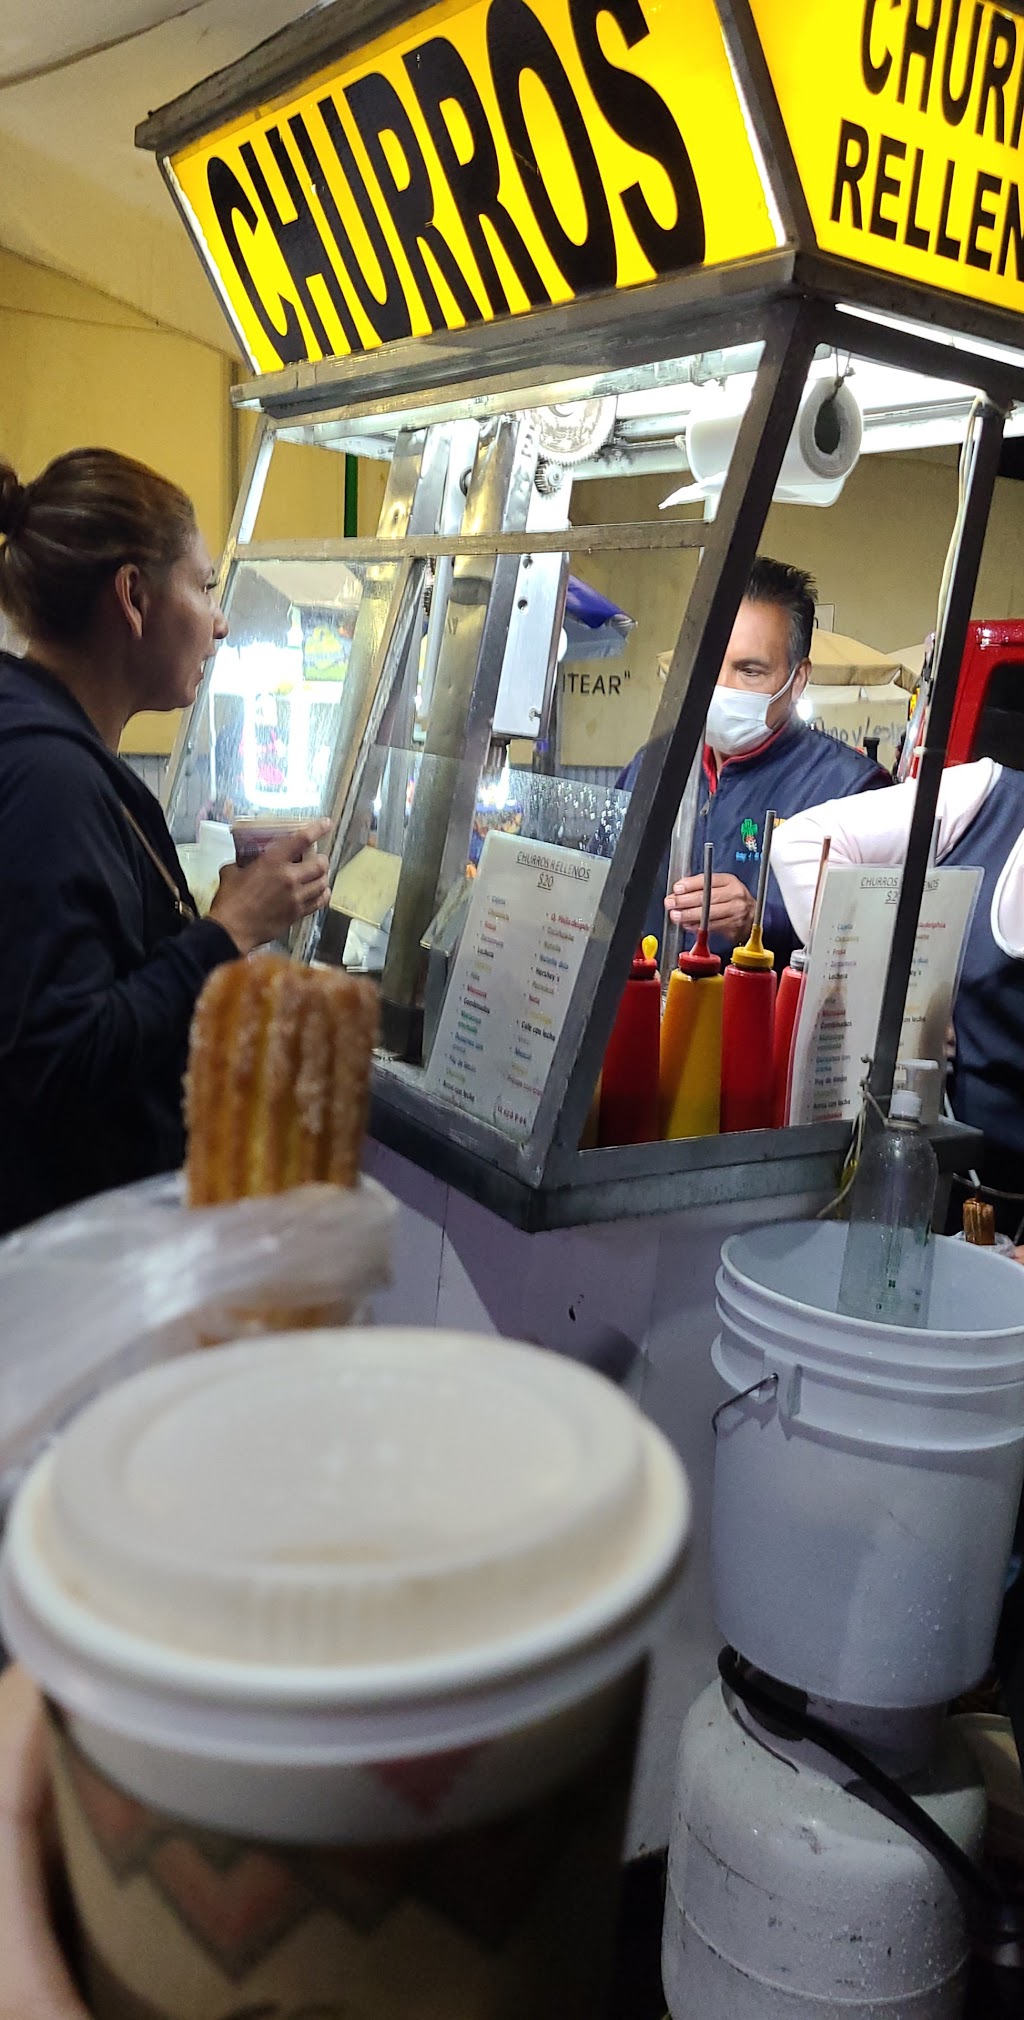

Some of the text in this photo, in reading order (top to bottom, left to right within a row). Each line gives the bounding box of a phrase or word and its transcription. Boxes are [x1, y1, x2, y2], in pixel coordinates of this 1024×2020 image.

[207, 0, 706, 365] CHURROS
[516, 851, 592, 880] CHURROS RELLENOS
[537, 871, 555, 889] $20
[860, 876, 899, 888] CHURROS
[886, 890, 900, 903] $2
